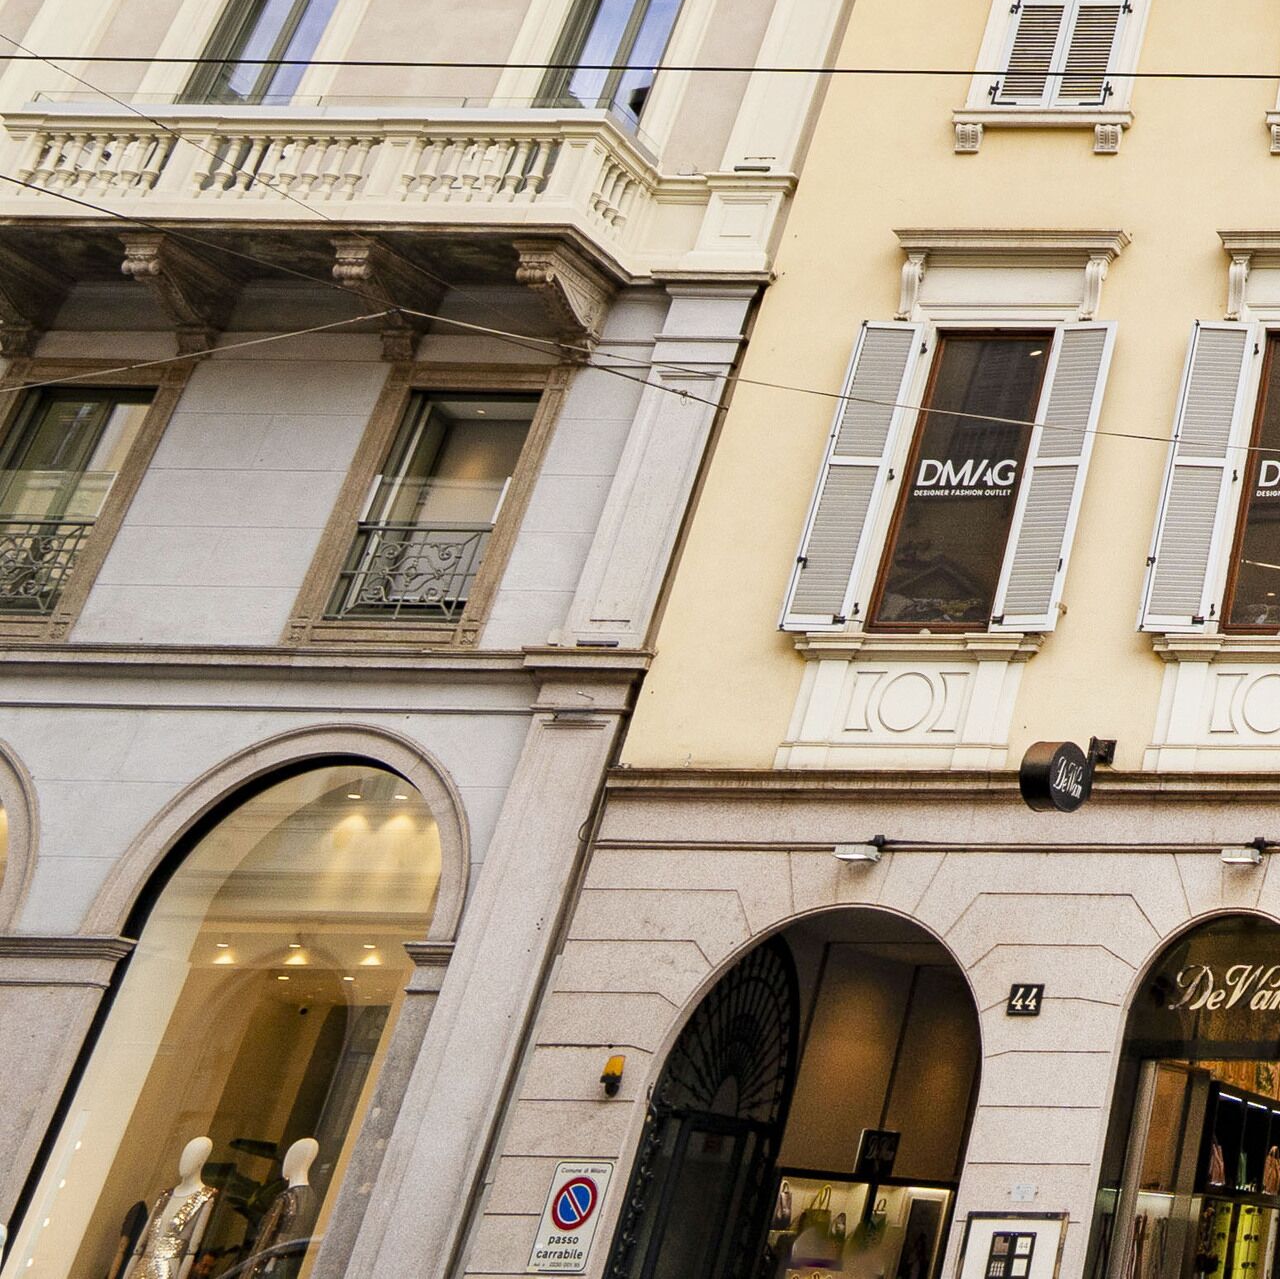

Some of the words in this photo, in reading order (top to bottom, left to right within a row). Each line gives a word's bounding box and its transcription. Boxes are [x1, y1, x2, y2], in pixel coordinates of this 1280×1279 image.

[916, 458, 1018, 487] DMAG
[1011, 987, 1038, 1010] 44
[548, 1235, 580, 1246] passo
[536, 1248, 584, 1260] carrabile
